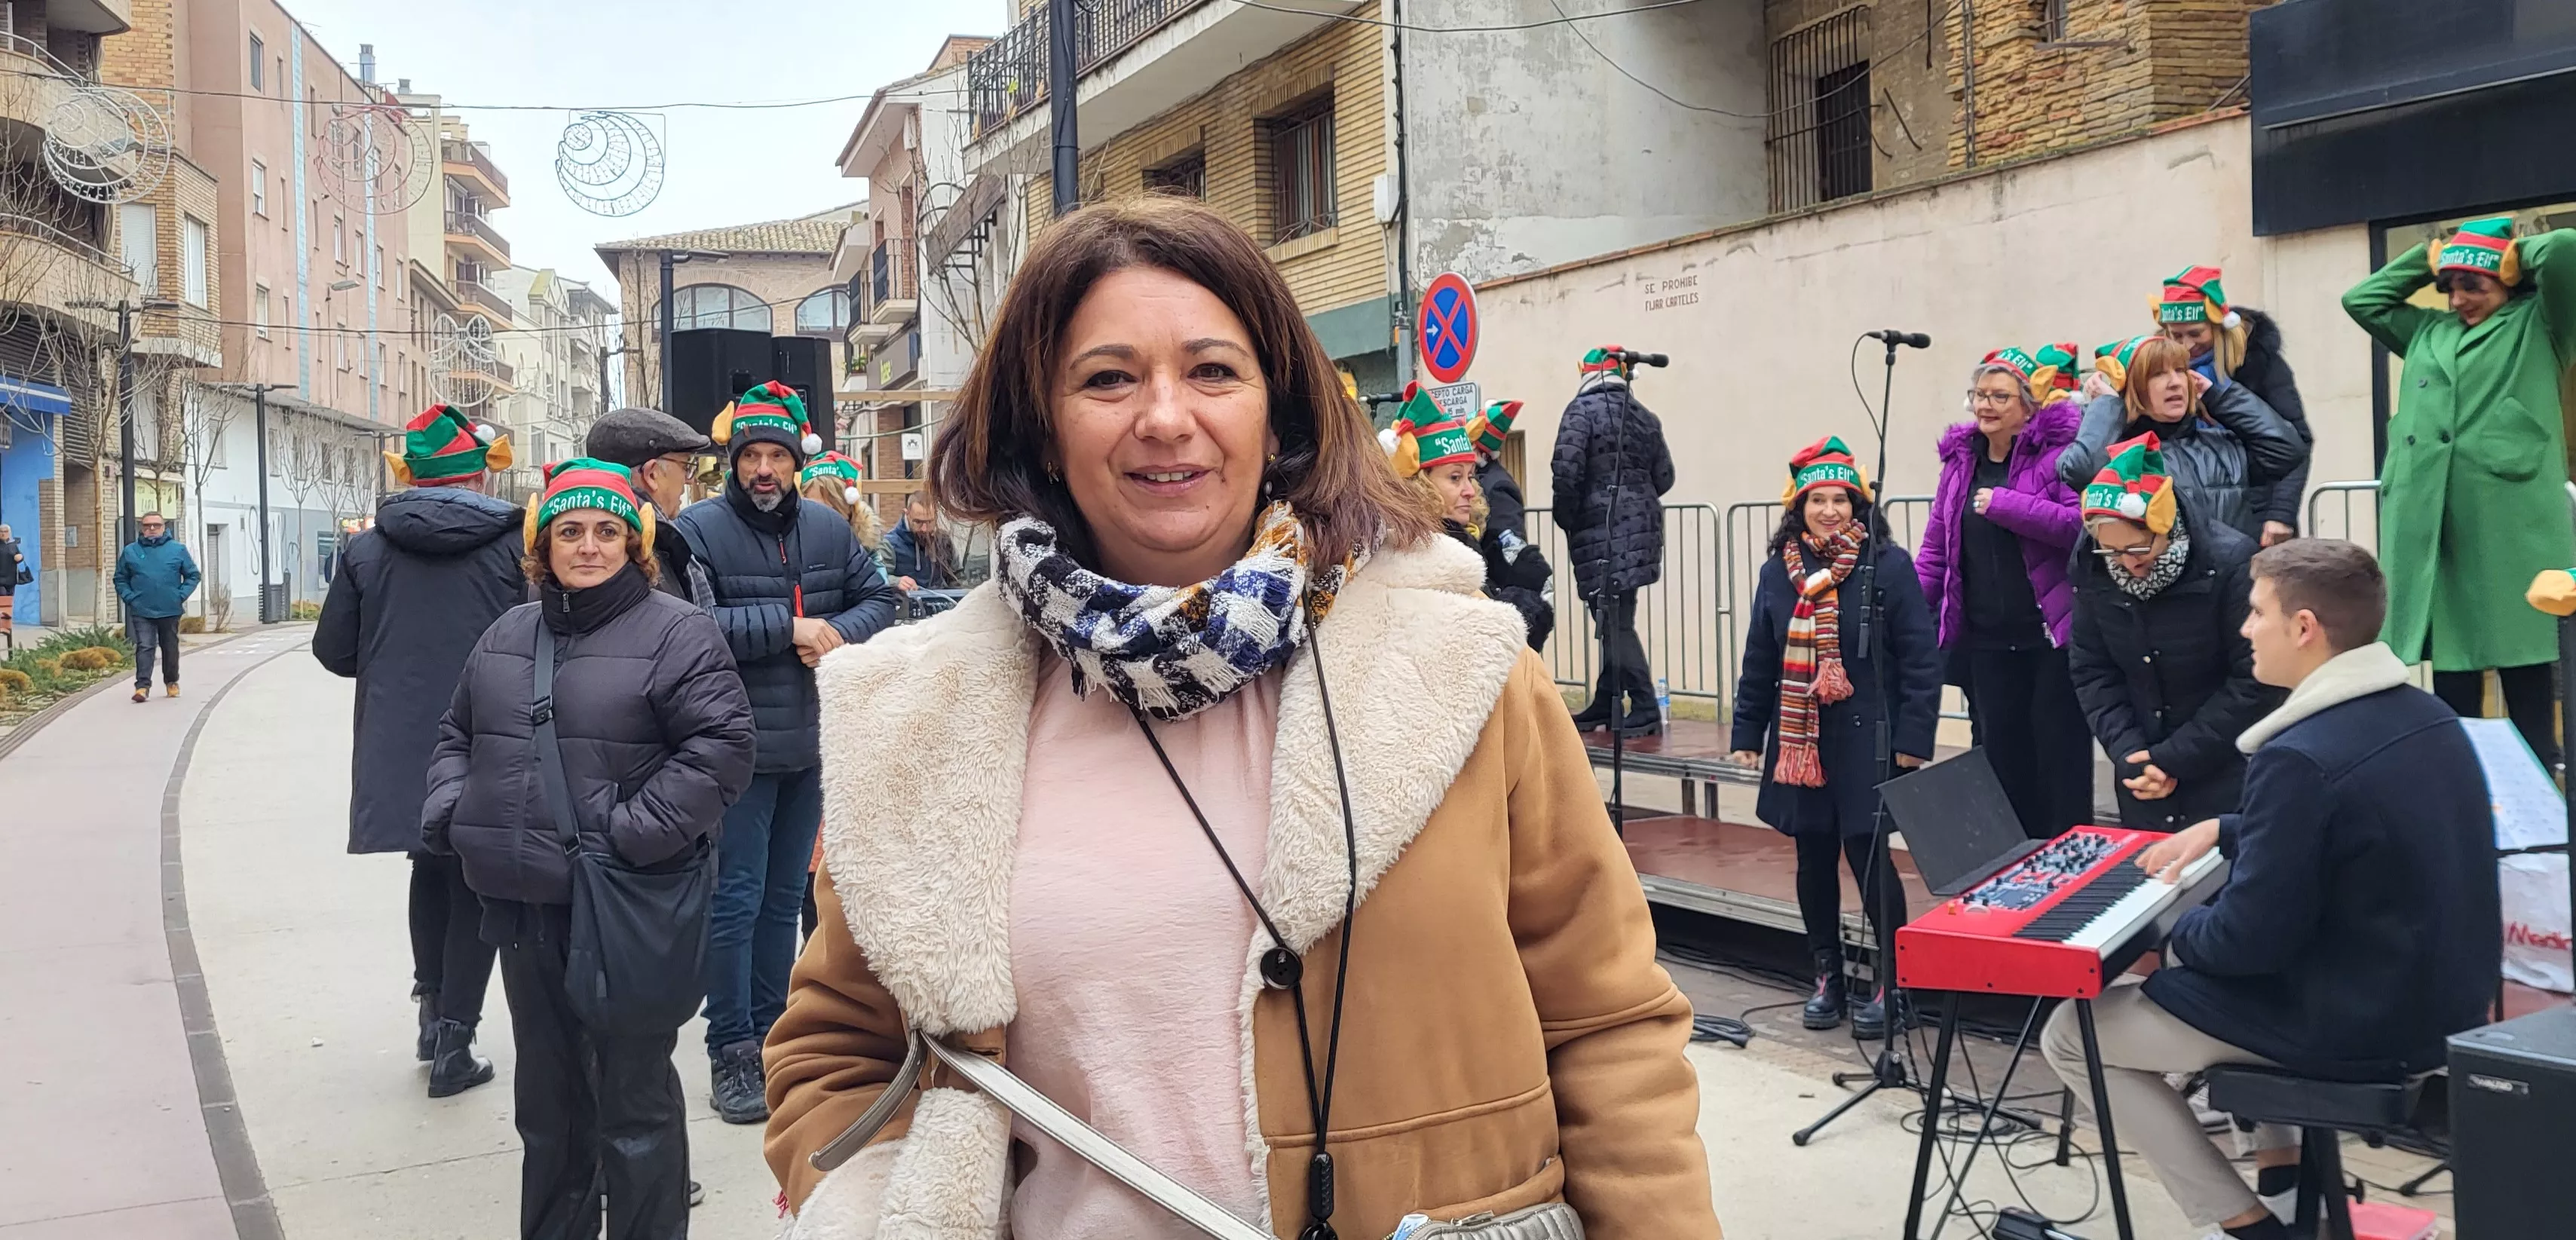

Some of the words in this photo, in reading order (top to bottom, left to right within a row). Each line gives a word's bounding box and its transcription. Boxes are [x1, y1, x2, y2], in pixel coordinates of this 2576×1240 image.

[1644, 283, 1656, 294] SE
[1662, 274, 1698, 292] PROHIBE
[1665, 292, 1699, 308] CARTELES
[1453, 385, 1473, 396] CARGA
